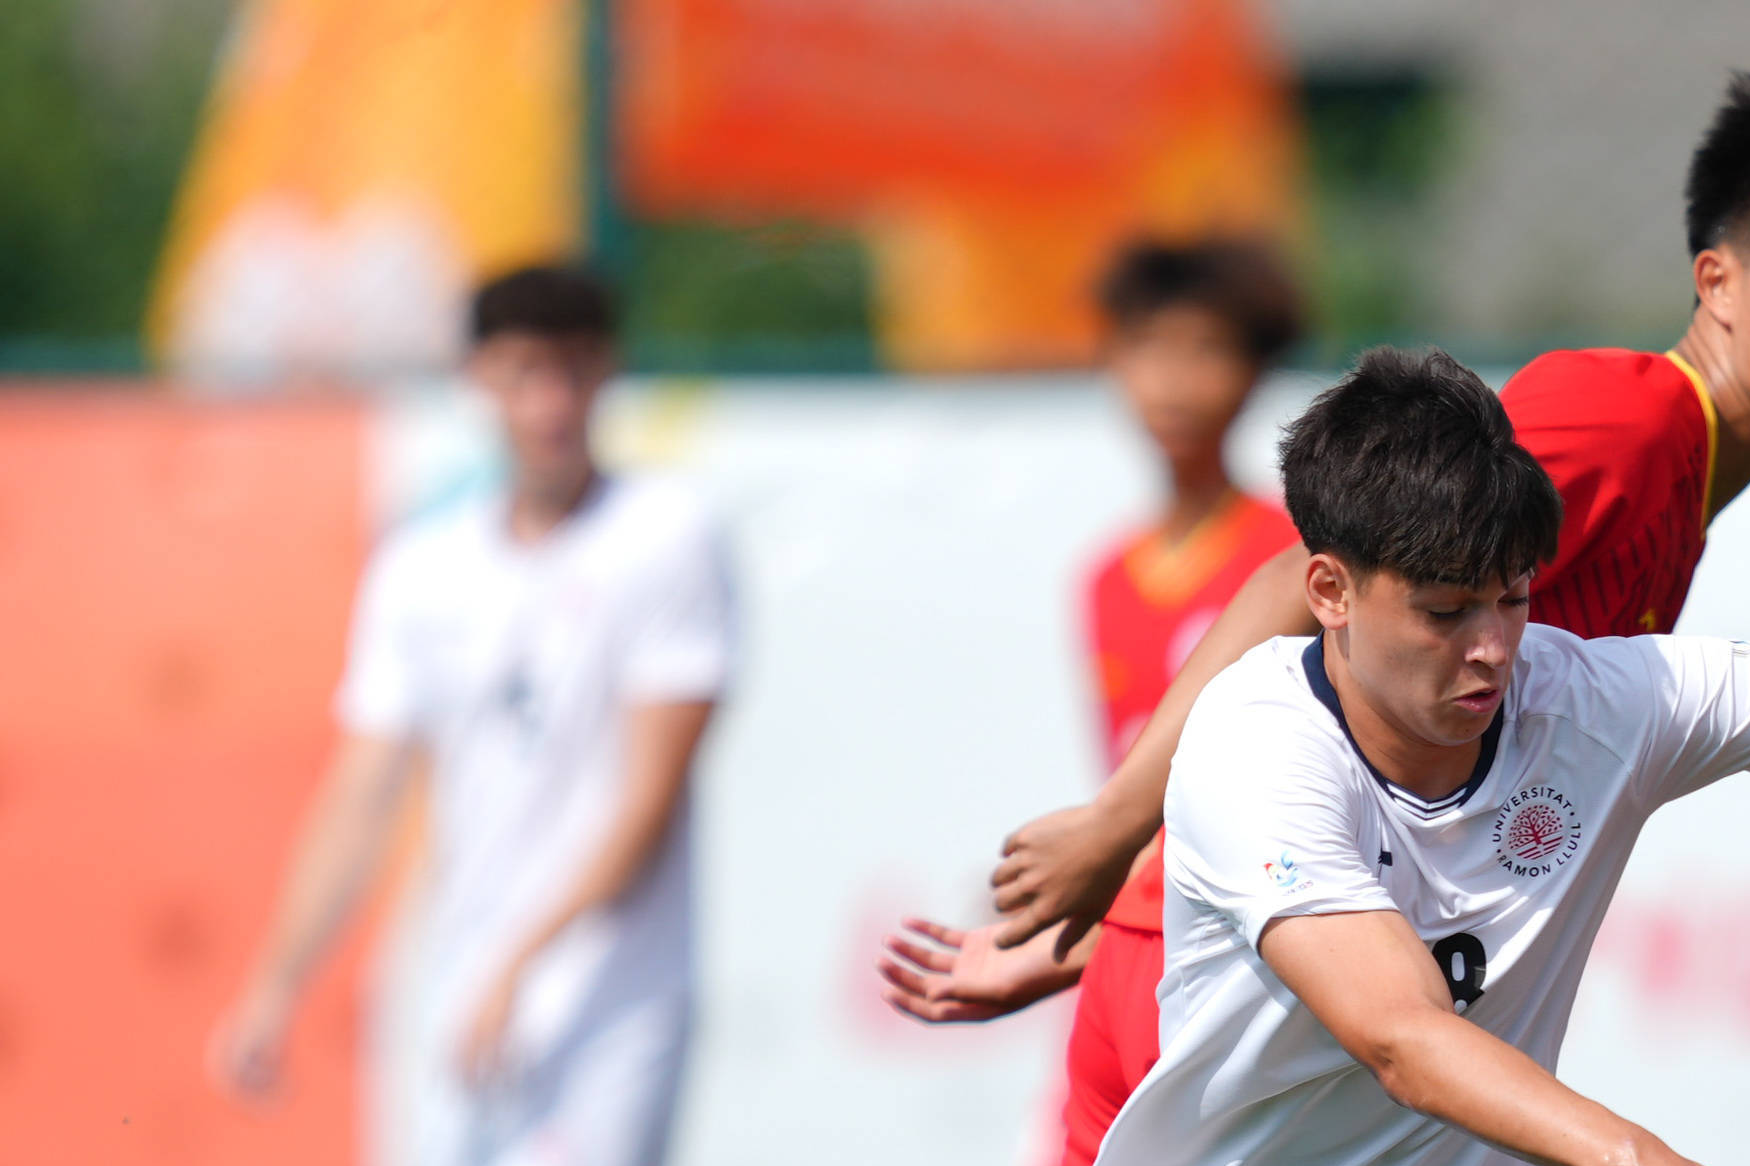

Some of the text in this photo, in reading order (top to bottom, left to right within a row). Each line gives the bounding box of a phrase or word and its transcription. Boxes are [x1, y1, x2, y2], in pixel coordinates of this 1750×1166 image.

[1492, 786, 1573, 843] UNIVERSITAT
[1496, 822, 1583, 878] RAMON LLULL
